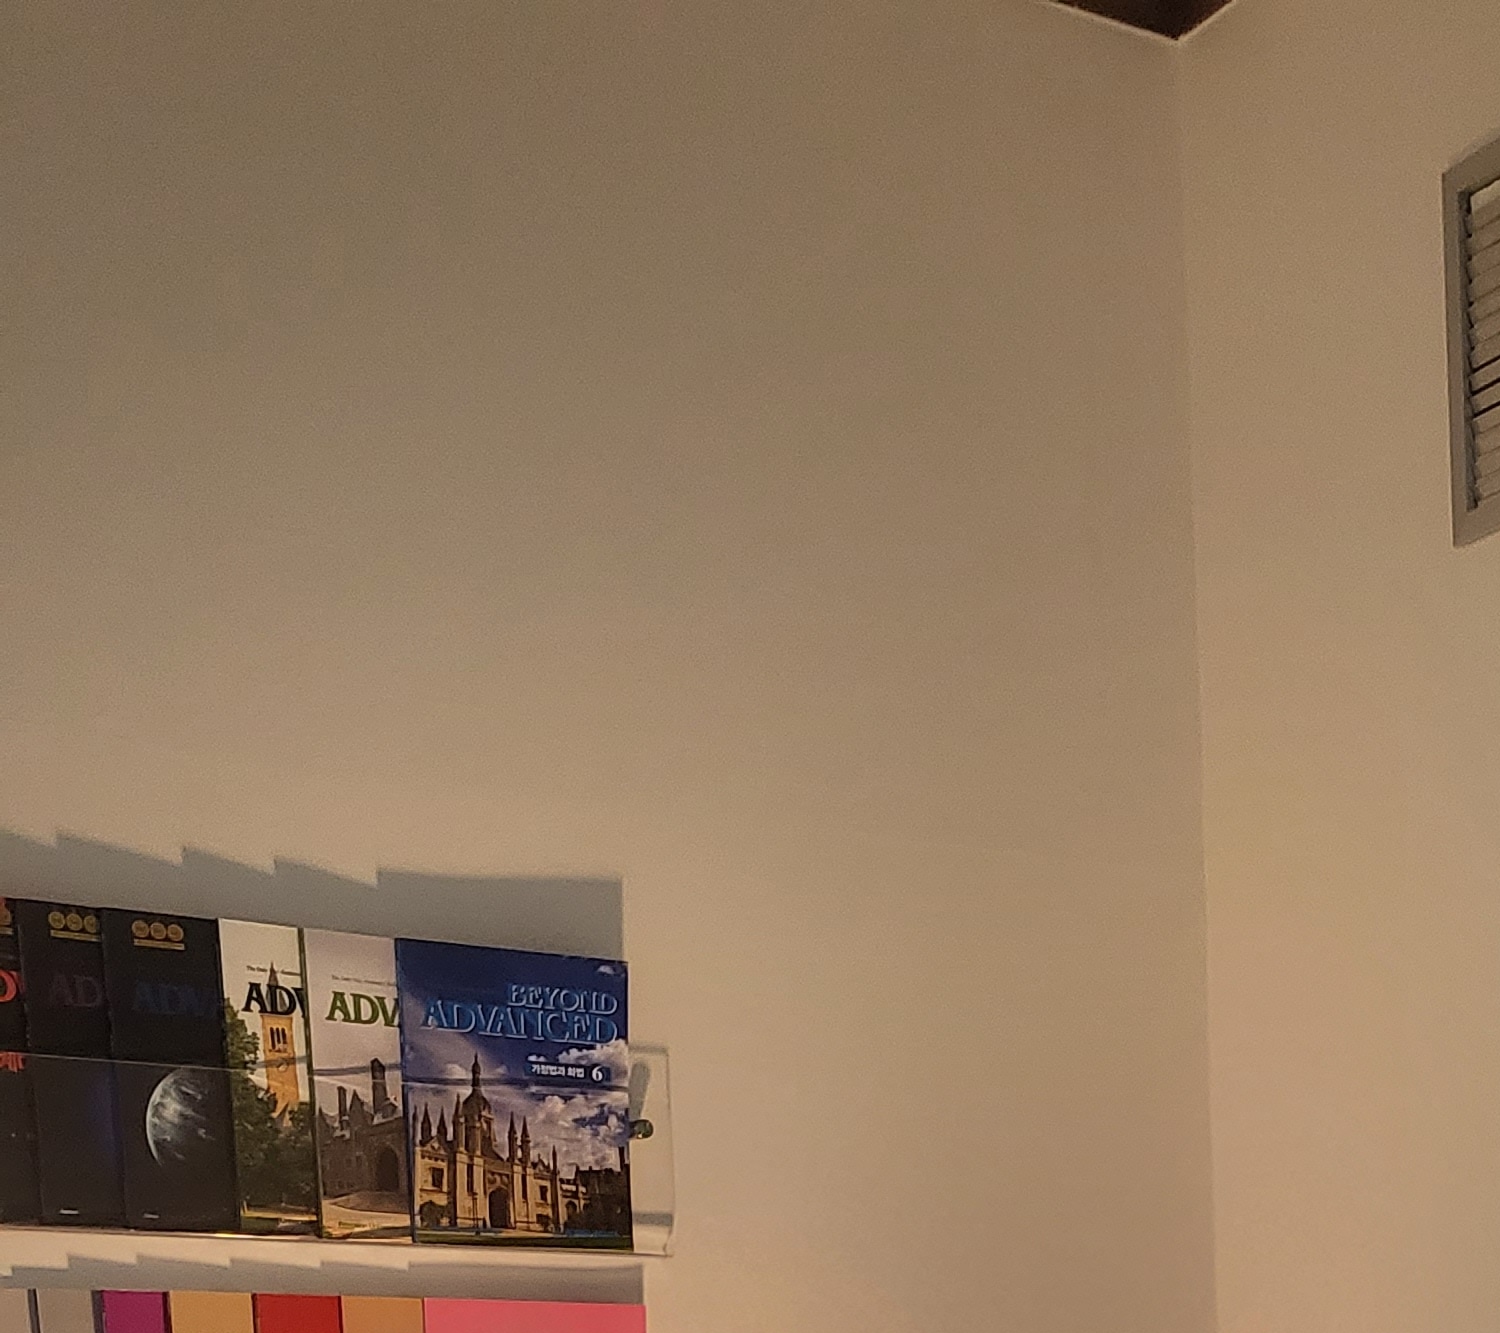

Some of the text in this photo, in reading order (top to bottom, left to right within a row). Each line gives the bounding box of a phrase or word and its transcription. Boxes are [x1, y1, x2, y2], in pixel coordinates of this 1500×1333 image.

[508, 984, 618, 1015] BEYOND
[420, 1000, 618, 1044] ADVANCED
[591, 1065, 603, 1082] 6
